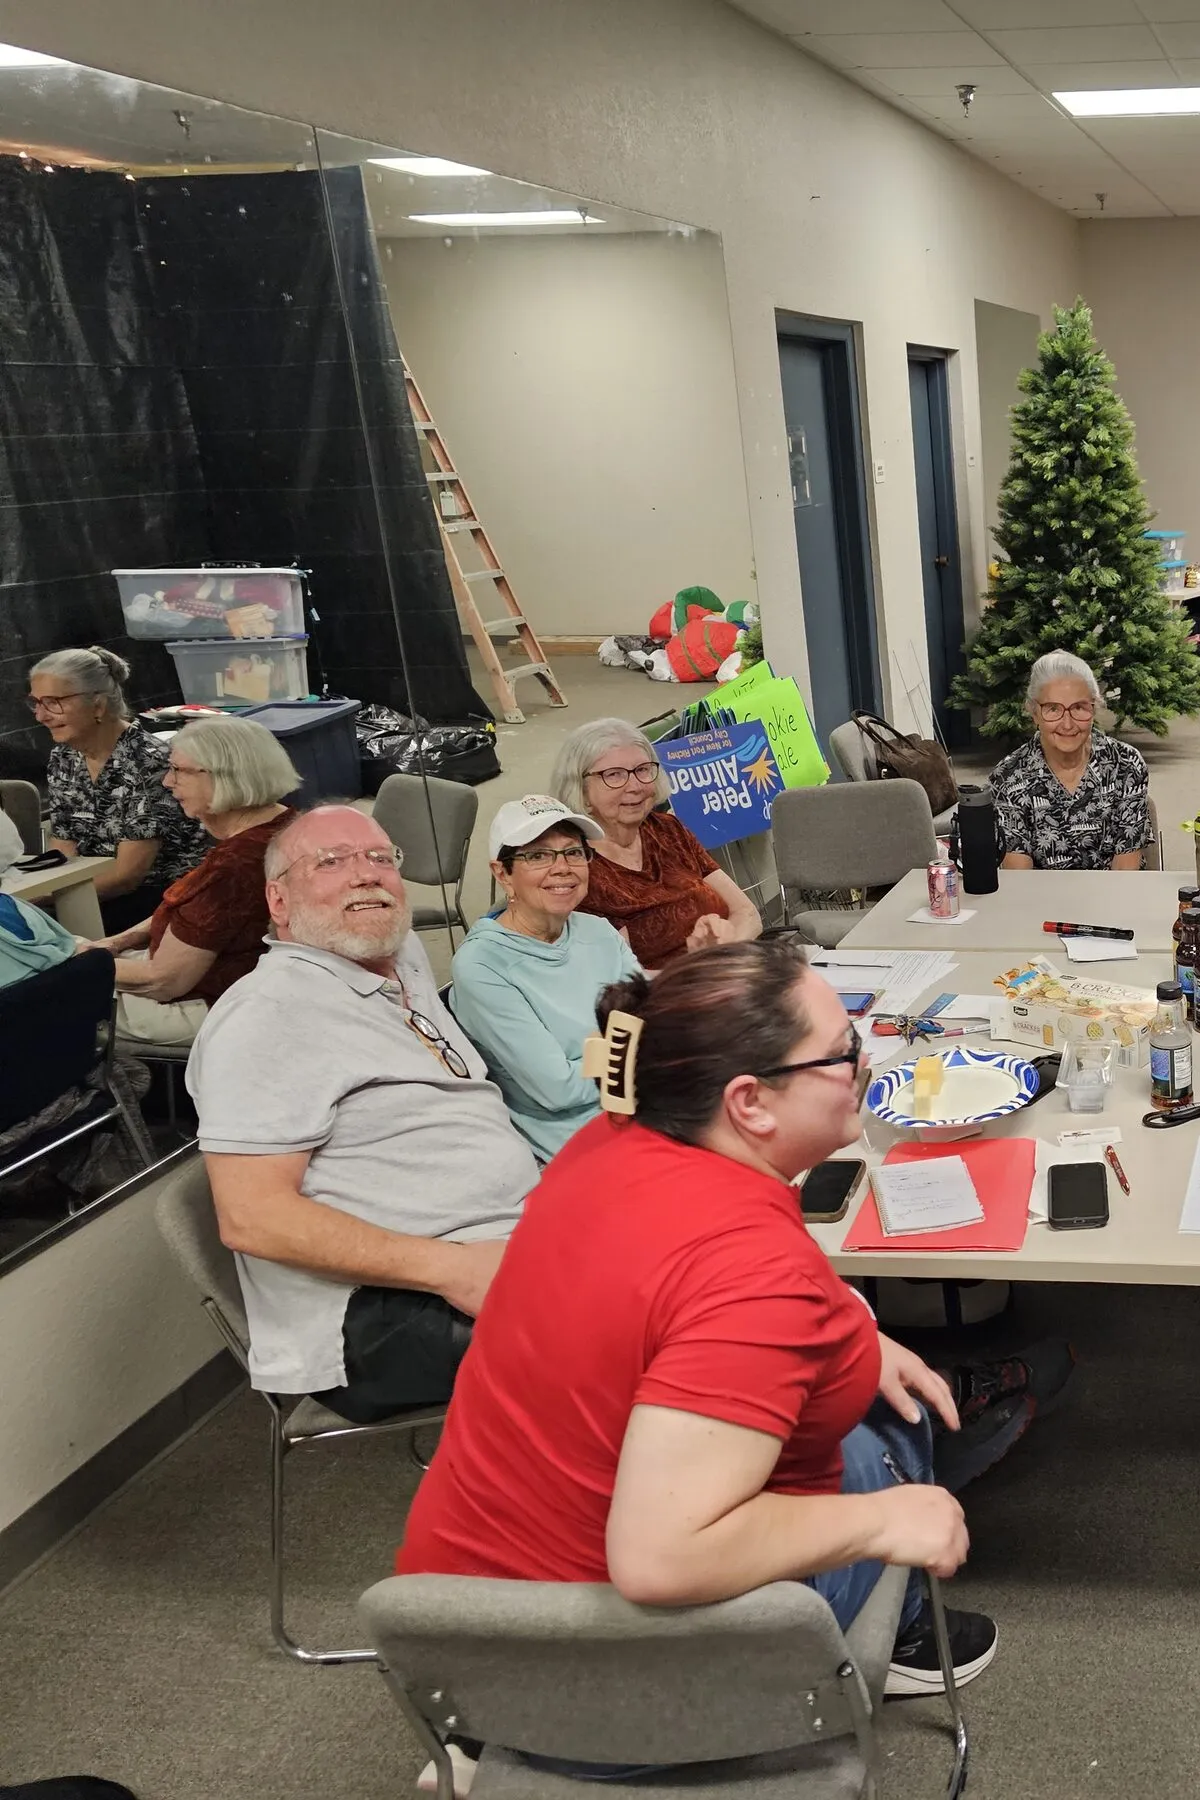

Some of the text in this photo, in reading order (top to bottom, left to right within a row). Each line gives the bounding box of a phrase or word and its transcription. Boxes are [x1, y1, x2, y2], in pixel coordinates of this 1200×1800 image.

[667, 738, 733, 761] for New Port Richey
[688, 729, 728, 745] City Council
[777, 741, 799, 770] ale
[702, 780, 752, 816] Peter
